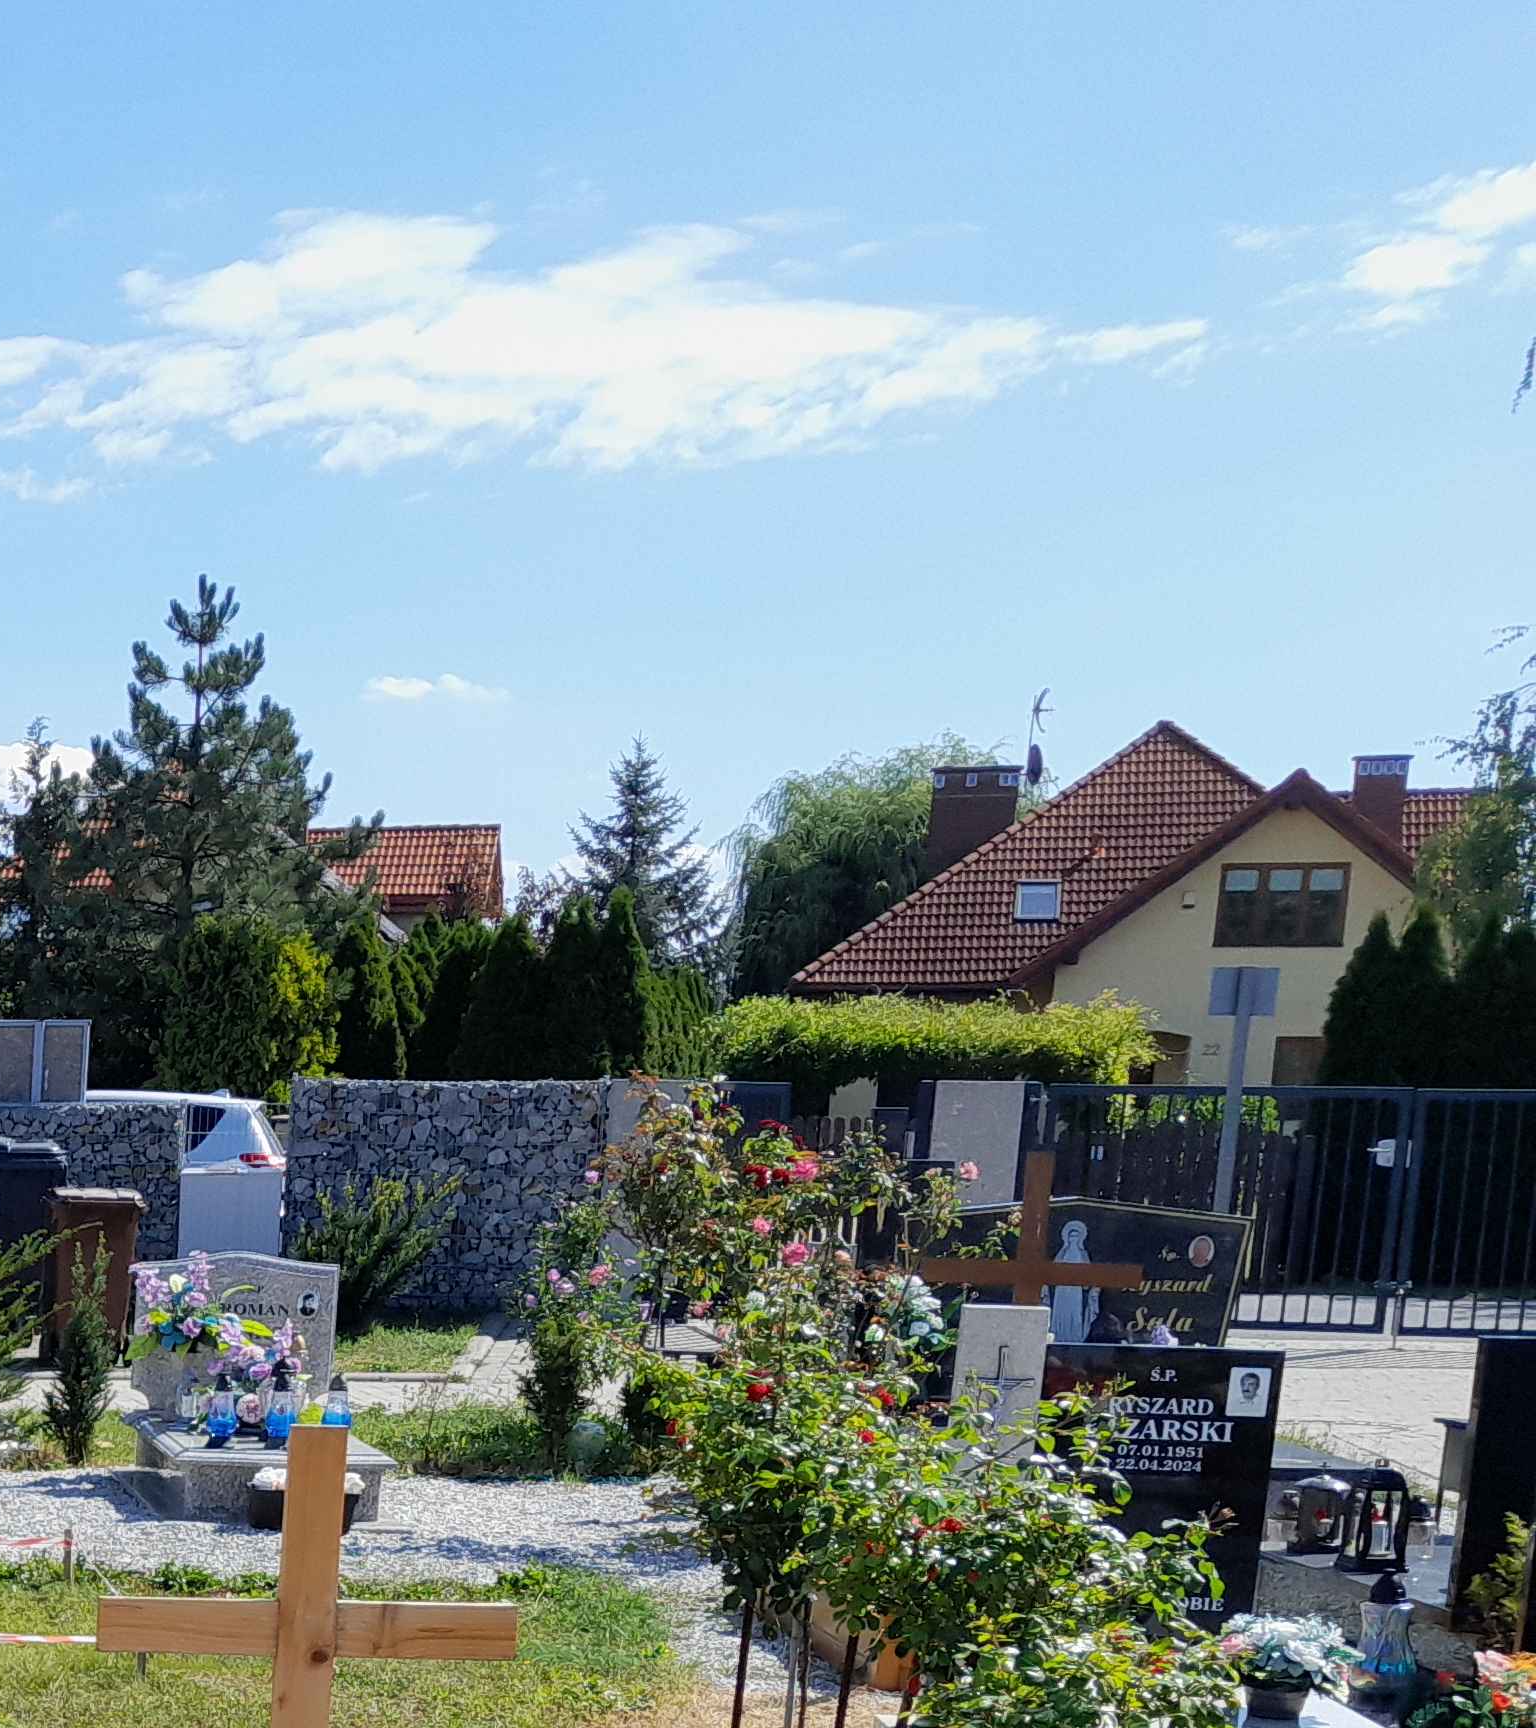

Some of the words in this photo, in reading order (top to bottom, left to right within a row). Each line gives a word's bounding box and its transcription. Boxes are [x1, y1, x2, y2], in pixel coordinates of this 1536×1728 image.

[1121, 1273, 1213, 1296] yszard
[1150, 1366, 1178, 1383] Ś.P.
[1109, 1398, 1214, 1416] RYSZARD
[1118, 1445, 1204, 1459] 07.01.1951
[1115, 1458, 1202, 1473] 22.04.2024
